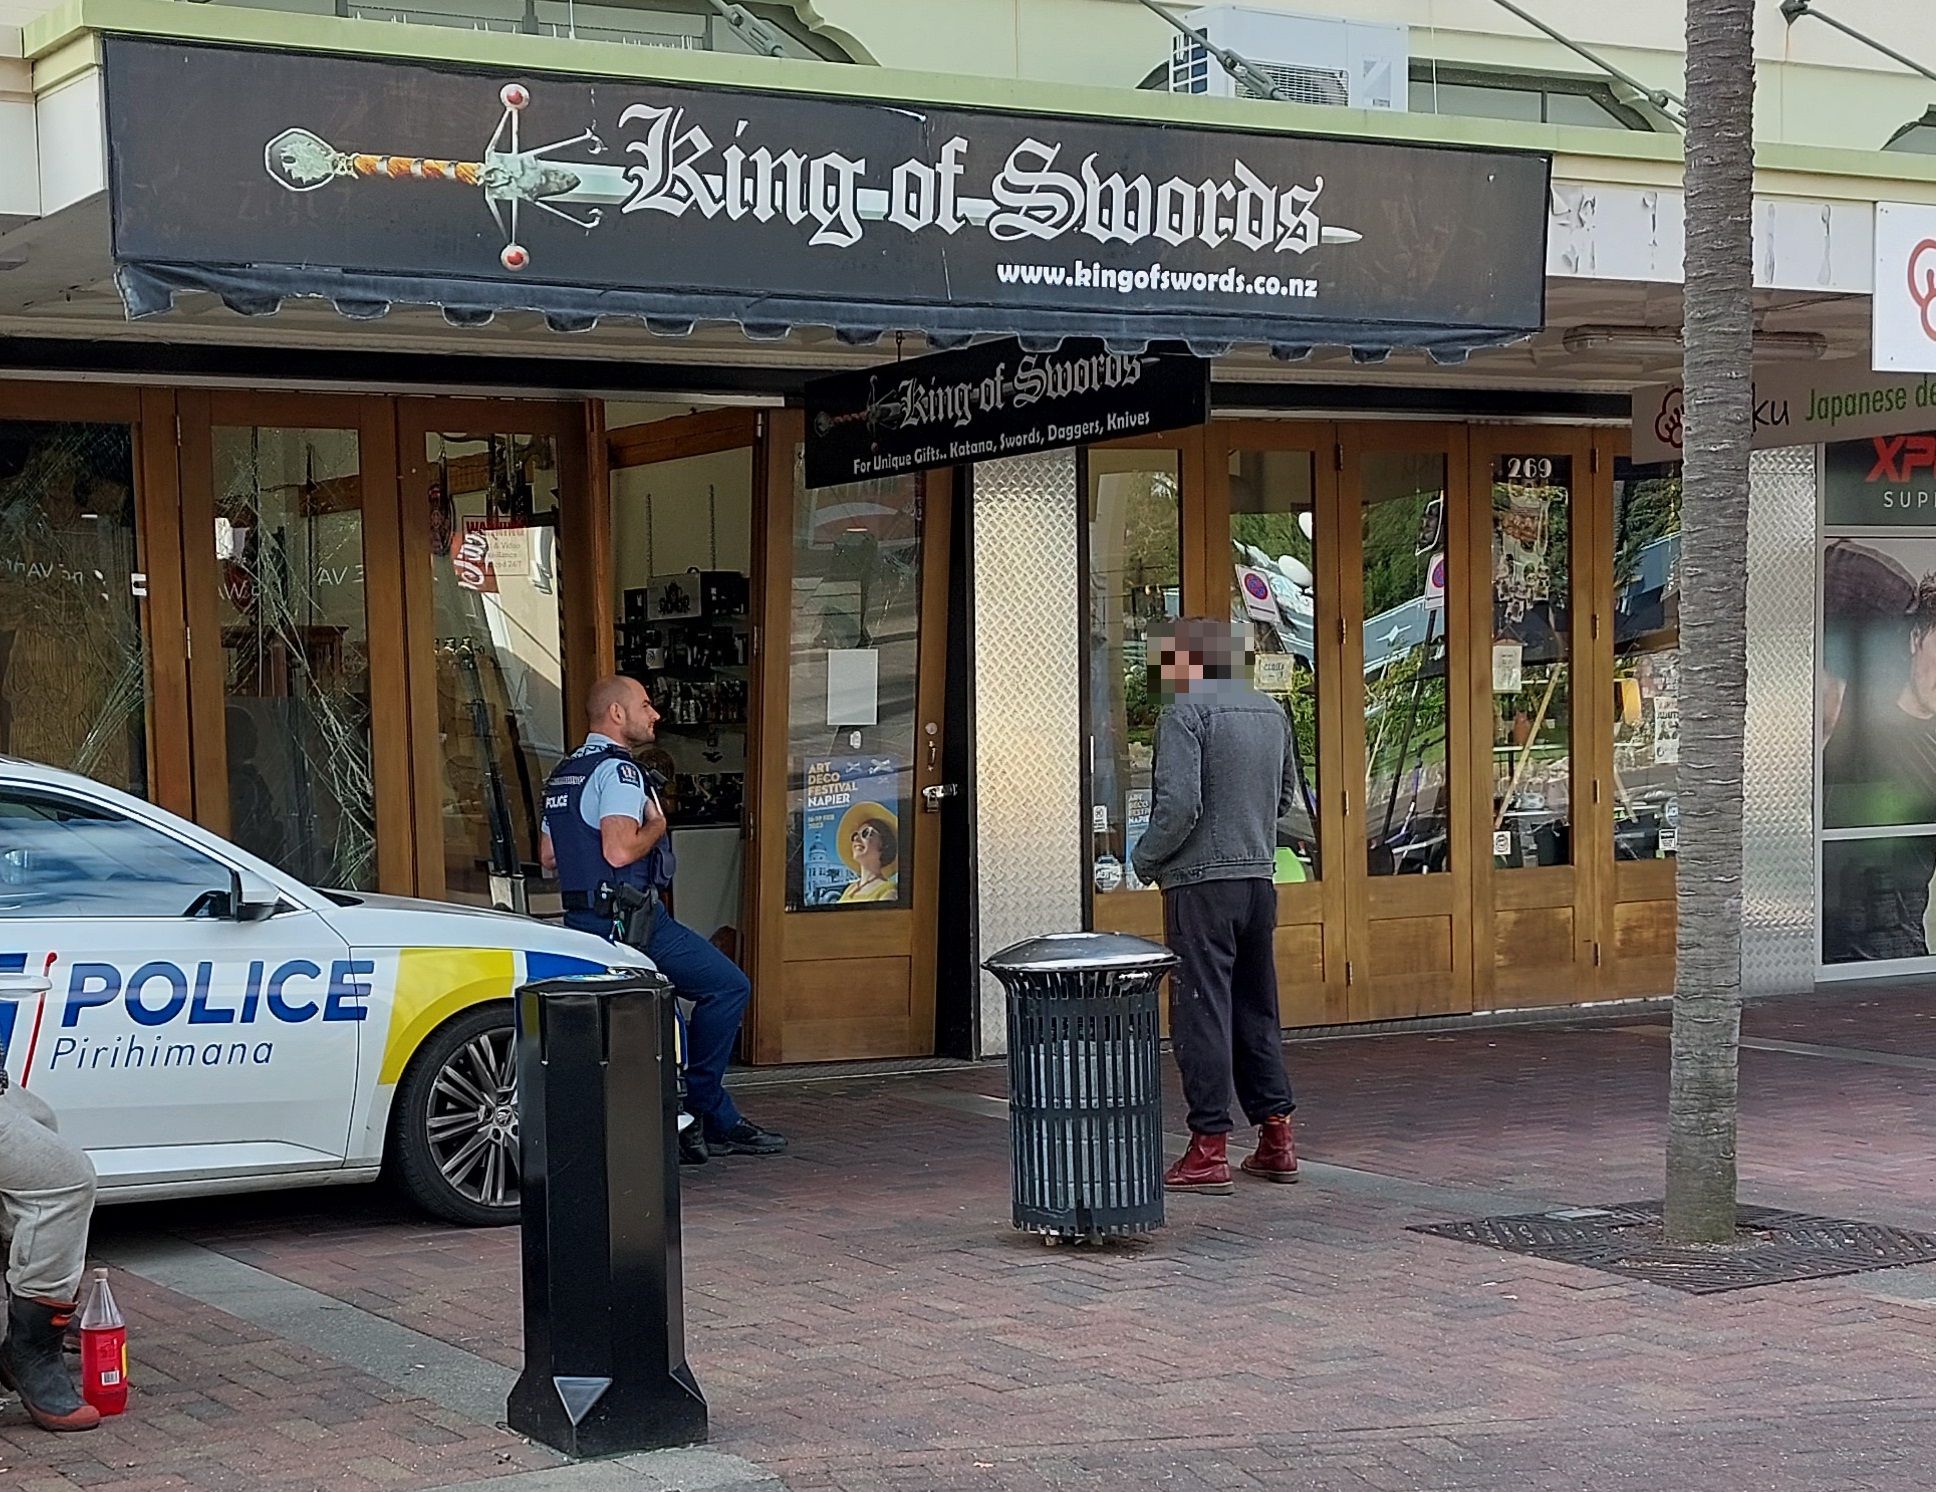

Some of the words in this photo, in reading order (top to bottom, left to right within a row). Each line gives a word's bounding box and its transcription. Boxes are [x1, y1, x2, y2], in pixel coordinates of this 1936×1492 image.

[618, 104, 866, 248] King
[888, 136, 969, 235] of
[988, 137, 1324, 255] Swords
[997, 259, 1319, 299] www.kingofswords.co.nz
[899, 375, 973, 428] King
[977, 361, 1006, 413] of
[1012, 353, 1141, 409] Swords
[1750, 382, 1790, 433] ku
[1805, 387, 1907, 427] Japanese
[852, 457, 872, 475] For
[873, 452, 912, 471] Unique
[949, 439, 997, 460] Katana,
[999, 429, 1046, 450] Swords,
[1046, 420, 1104, 443] Daggers,
[1106, 410, 1151, 431] Knives
[1864, 435, 1936, 482] XP
[1507, 457, 1553, 478] 269
[1883, 491, 1936, 508] SUP
[808, 761, 832, 775] ART
[808, 772, 840, 785] DECO
[545, 794, 569, 809] POLICE
[808, 781, 859, 797] FESTIVAL
[808, 793, 850, 808] NAPIER
[61, 959, 375, 1028] POLICE
[50, 1034, 274, 1070] Pirihimana
